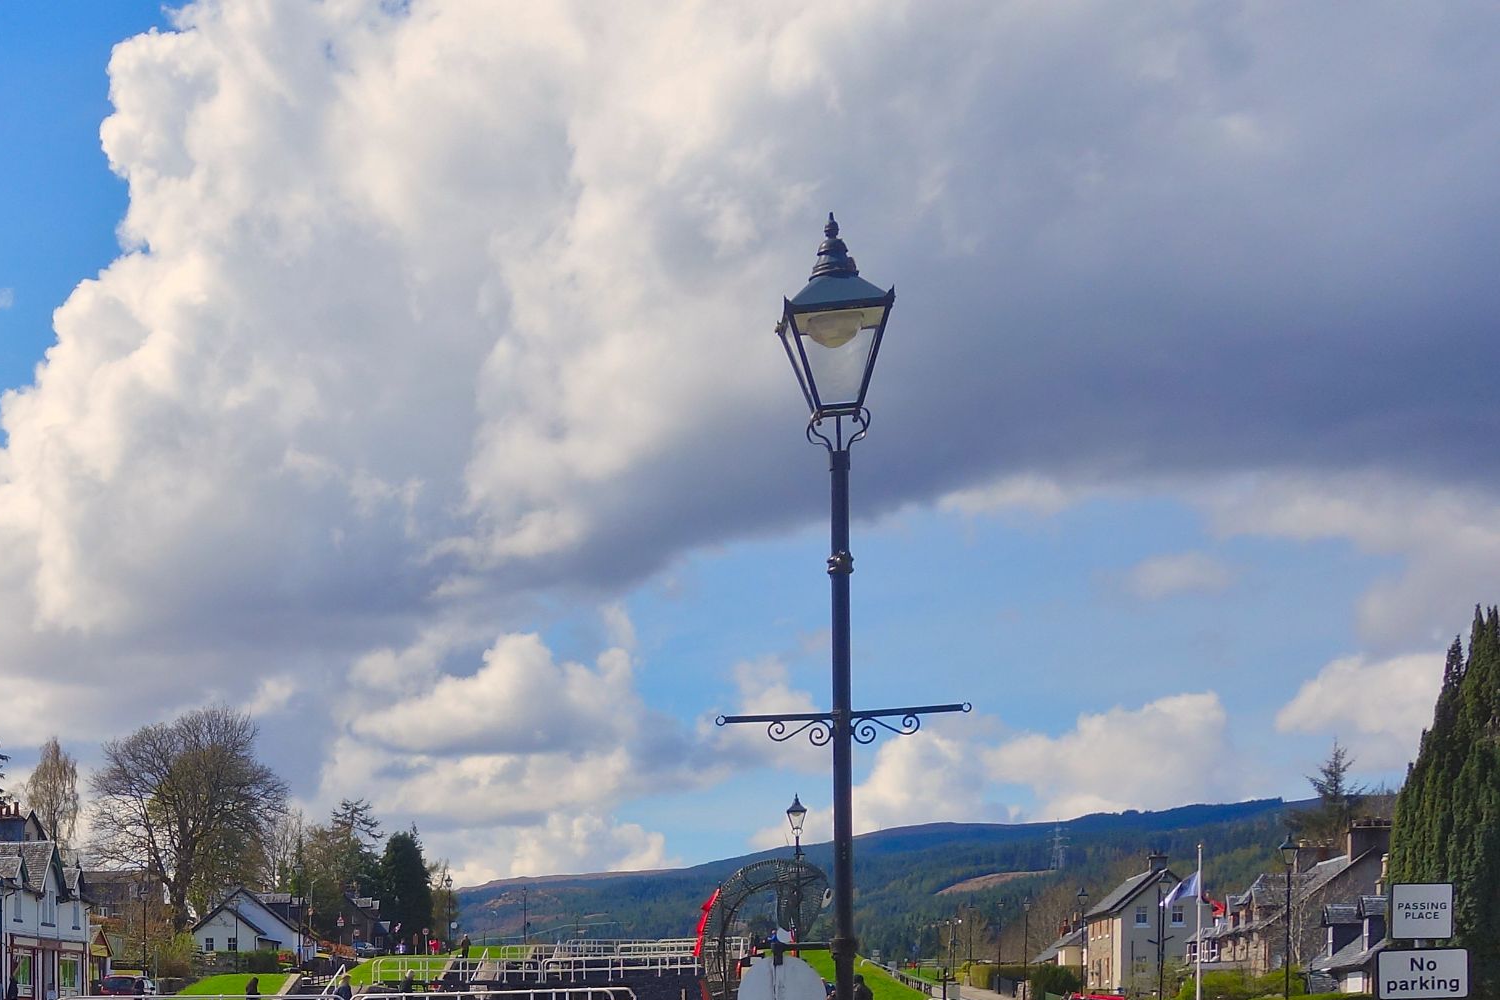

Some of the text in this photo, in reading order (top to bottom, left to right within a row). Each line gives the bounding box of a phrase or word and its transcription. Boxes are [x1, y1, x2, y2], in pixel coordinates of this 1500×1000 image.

[1397, 902, 1447, 910] PASSING
[1404, 911, 1439, 919] PLACE
[1410, 957, 1437, 971] No
[1387, 976, 1460, 993] parking
